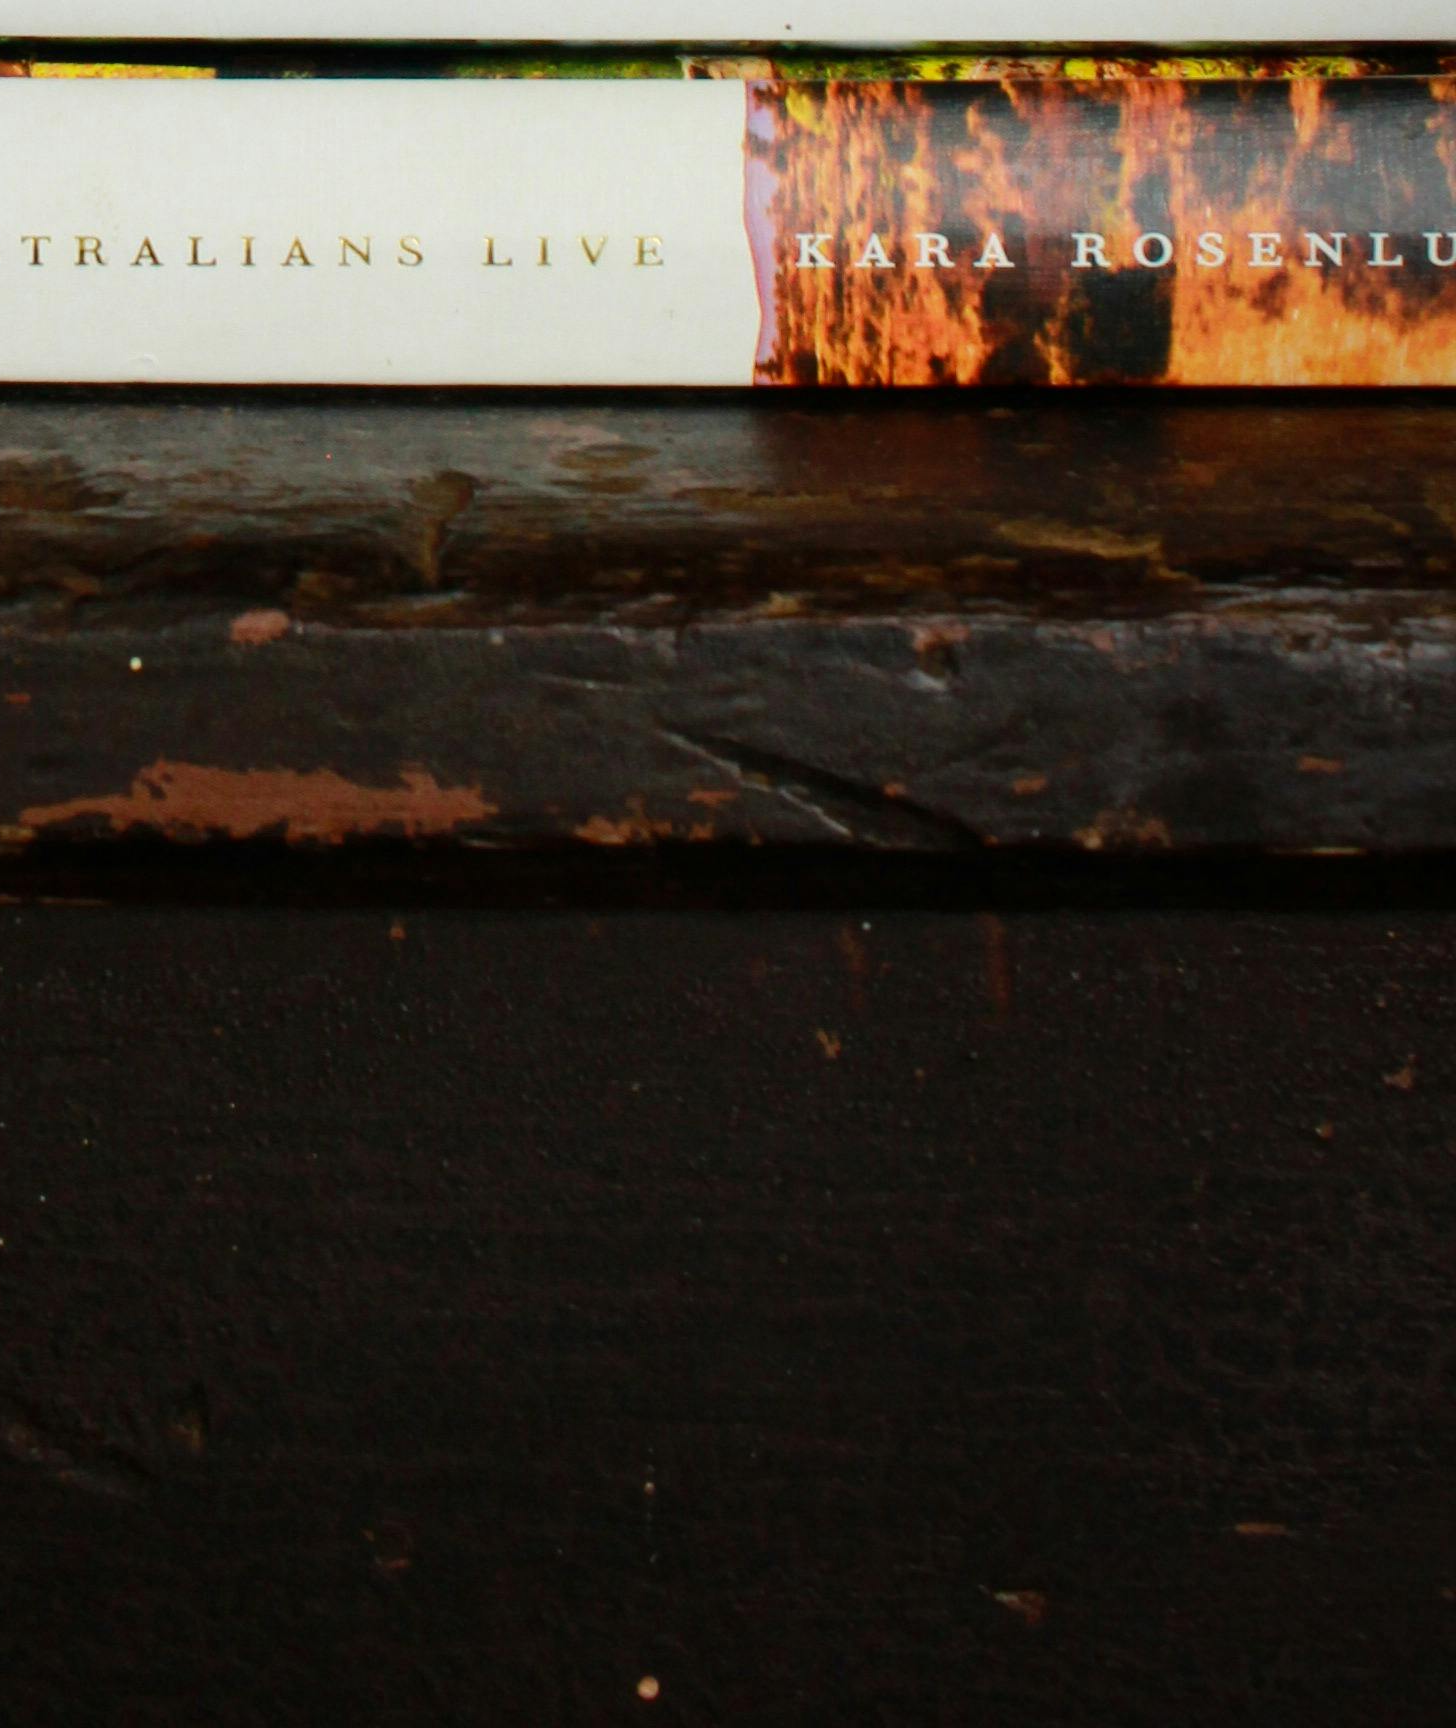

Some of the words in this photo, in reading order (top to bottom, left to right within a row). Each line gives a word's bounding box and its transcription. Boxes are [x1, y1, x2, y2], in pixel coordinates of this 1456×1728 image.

[482, 236, 665, 267] LIVE
[795, 227, 1015, 268] KARA
[1071, 231, 1456, 267] ROSENLU
